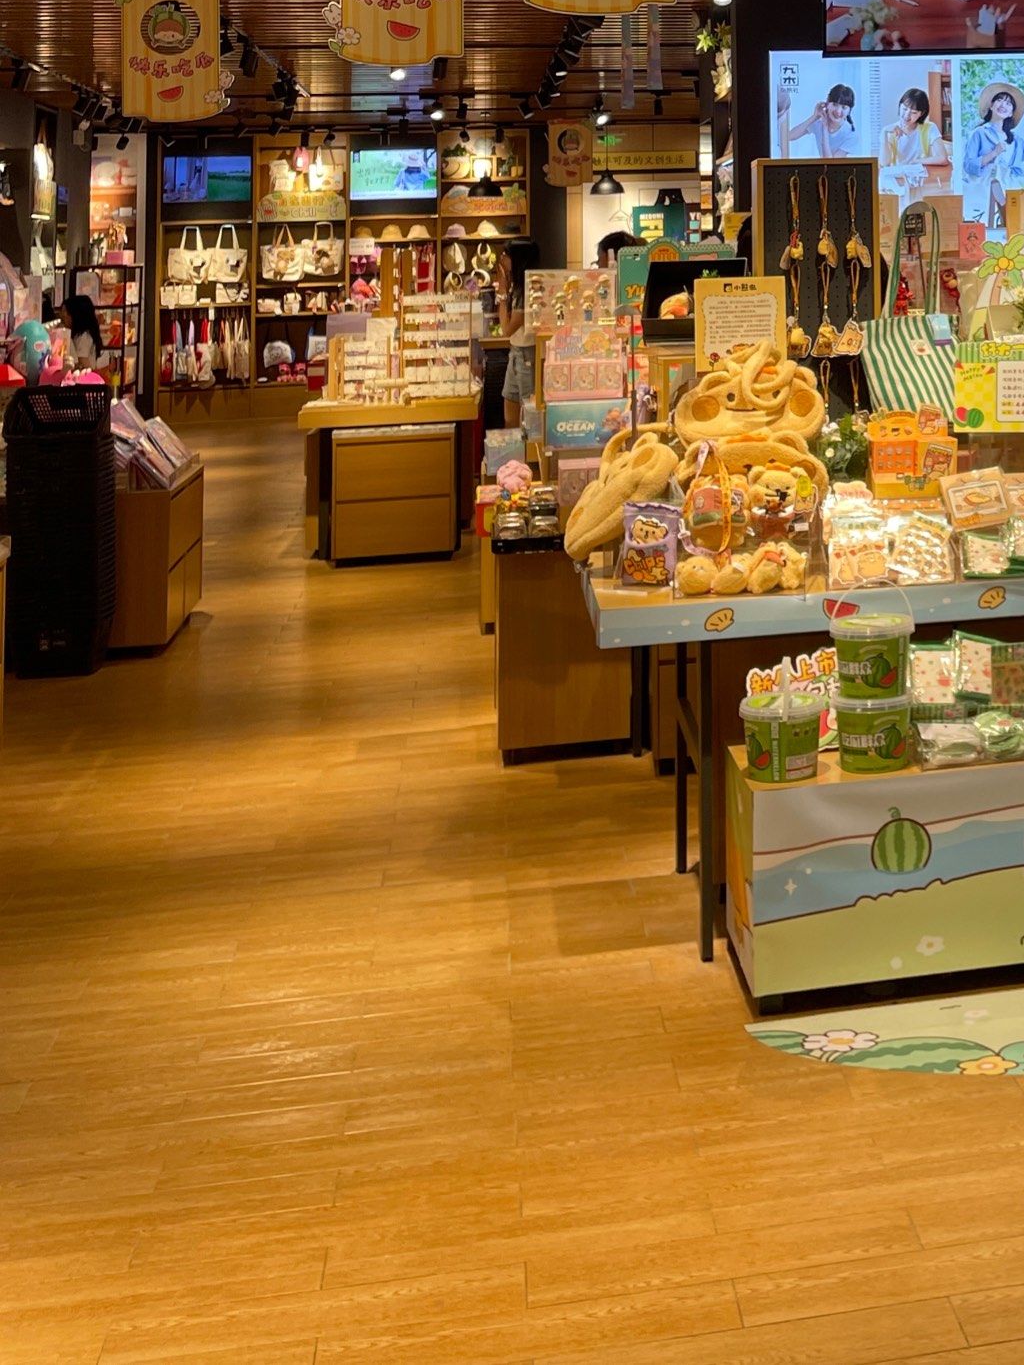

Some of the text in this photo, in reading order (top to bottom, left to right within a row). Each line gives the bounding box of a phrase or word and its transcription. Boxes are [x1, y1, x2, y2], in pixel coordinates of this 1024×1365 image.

[128, 51, 215, 79] 快乐吃瓜
[556, 421, 596, 433] OCEAN
[750, 649, 836, 694] 新上市
